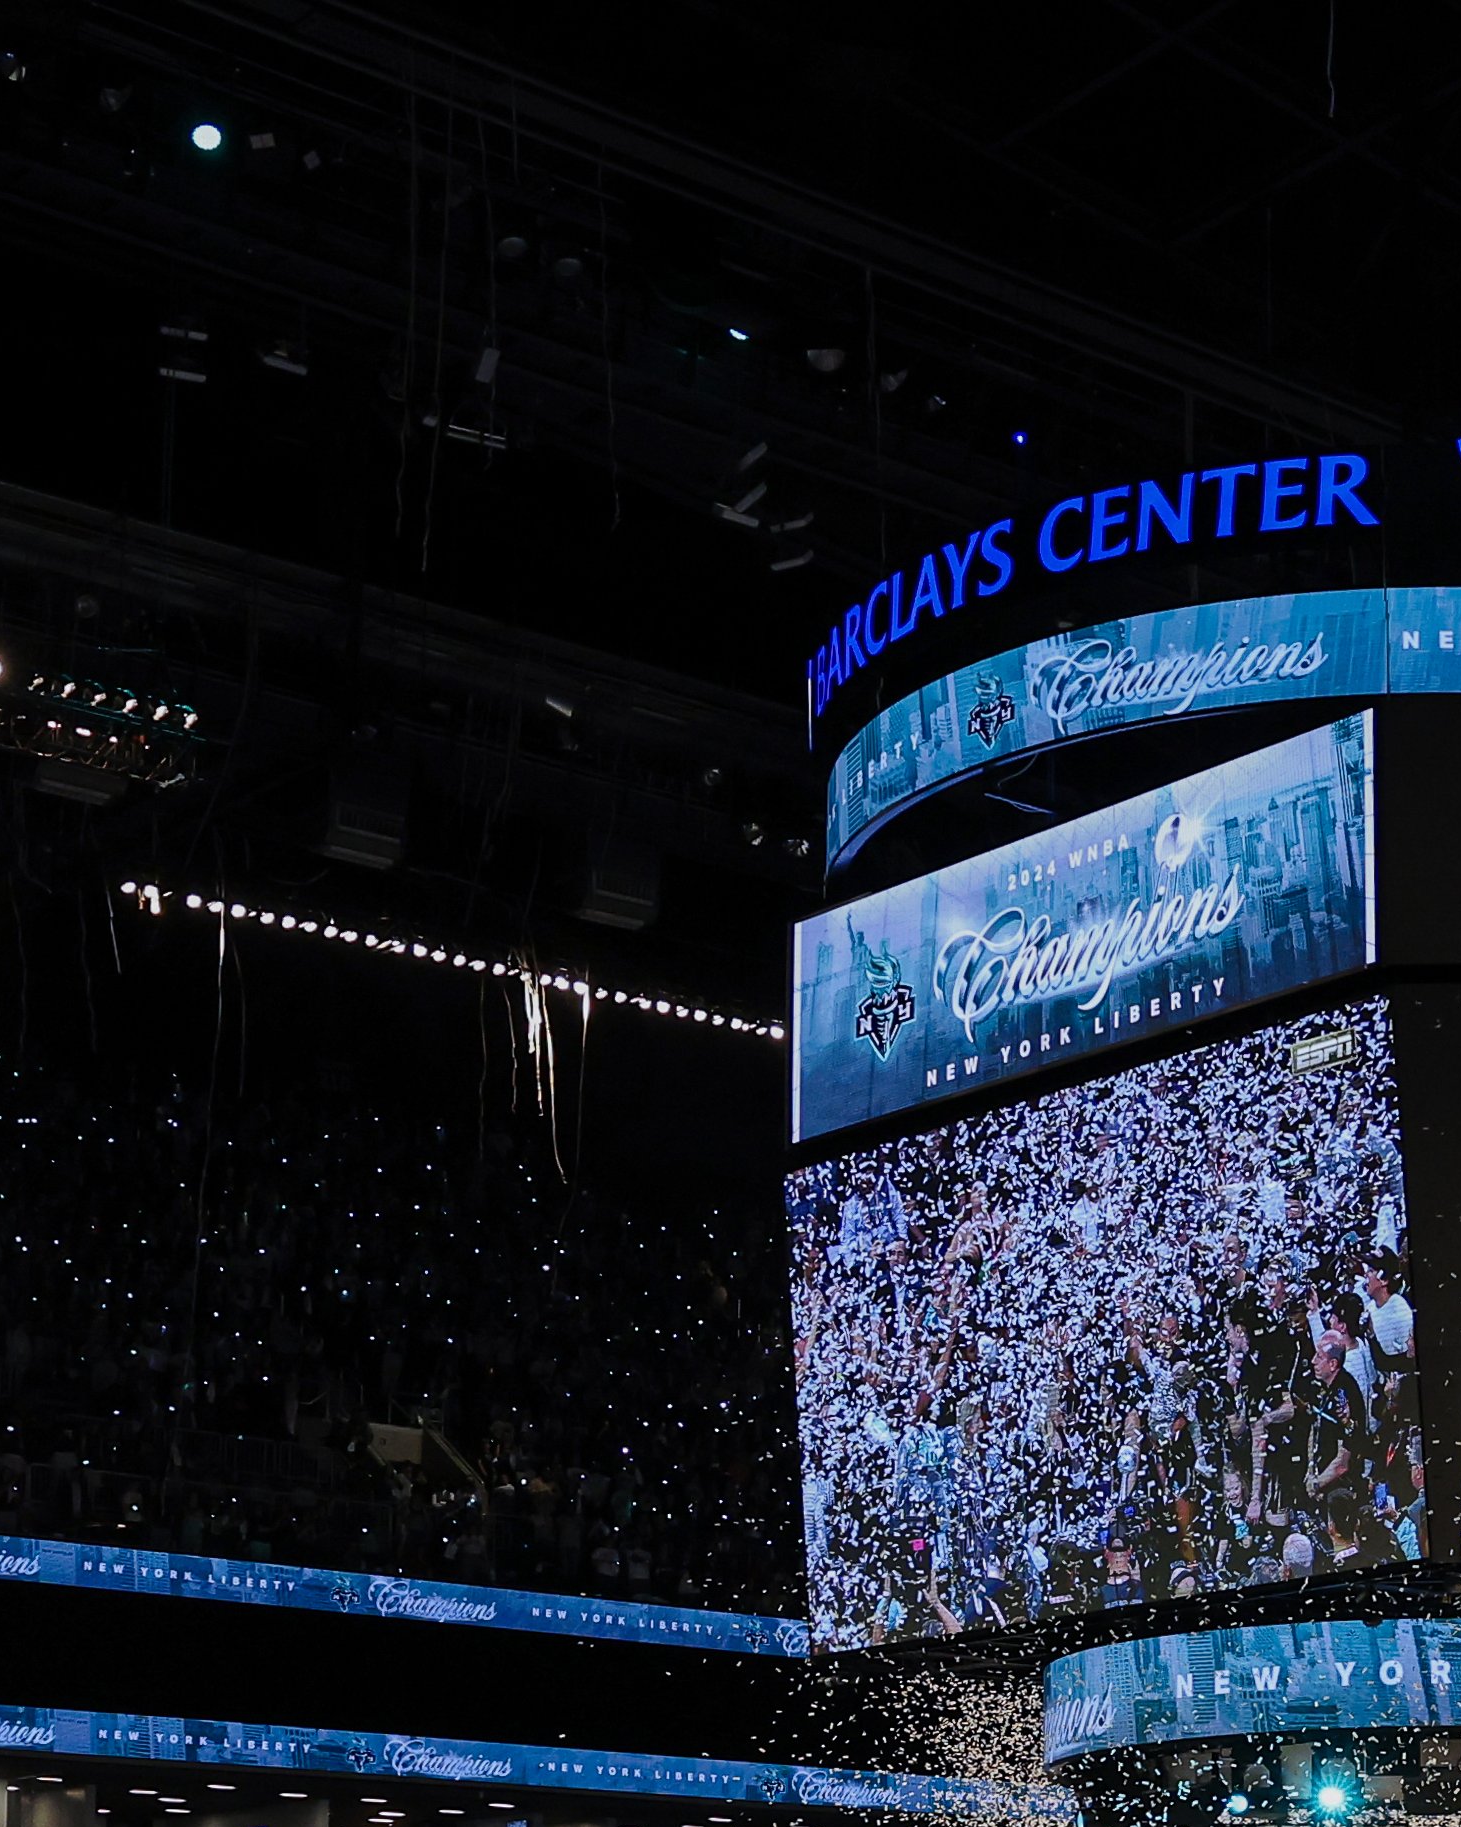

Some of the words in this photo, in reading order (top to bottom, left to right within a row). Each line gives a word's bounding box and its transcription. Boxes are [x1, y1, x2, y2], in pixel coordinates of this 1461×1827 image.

[815, 519, 1013, 718] BARCLAYS
[1039, 454, 1381, 573] CENTER
[1031, 631, 1328, 736] Champions
[1007, 858, 1057, 892] 2024
[1069, 832, 1131, 868] WNBA
[933, 864, 1246, 1044] Champions
[926, 1054, 979, 1088] NEW
[1000, 1026, 1072, 1065] YORK
[1094, 976, 1227, 1035] LIBERTY
[1296, 1033, 1353, 1069] ESPN
[83, 1560, 130, 1576] NEW
[140, 1566, 193, 1582] YORK
[208, 1573, 297, 1592] LIBERTY
[367, 1576, 497, 1623] Champions
[532, 1606, 570, 1620] NEW
[580, 1611, 627, 1626] YORK
[639, 1617, 717, 1635] LIBERTY
[1176, 1665, 1282, 1699] NEW
[98, 1728, 138, 1743] NEW
[155, 1733, 208, 1747] YORK
[224, 1738, 312, 1754] LIBERTY
[384, 1739, 513, 1779] Champions
[548, 1762, 587, 1774] NEW
[595, 1765, 643, 1778] YORK
[654, 1770, 731, 1784] LIBERTY
[792, 1770, 901, 1806] Champions
